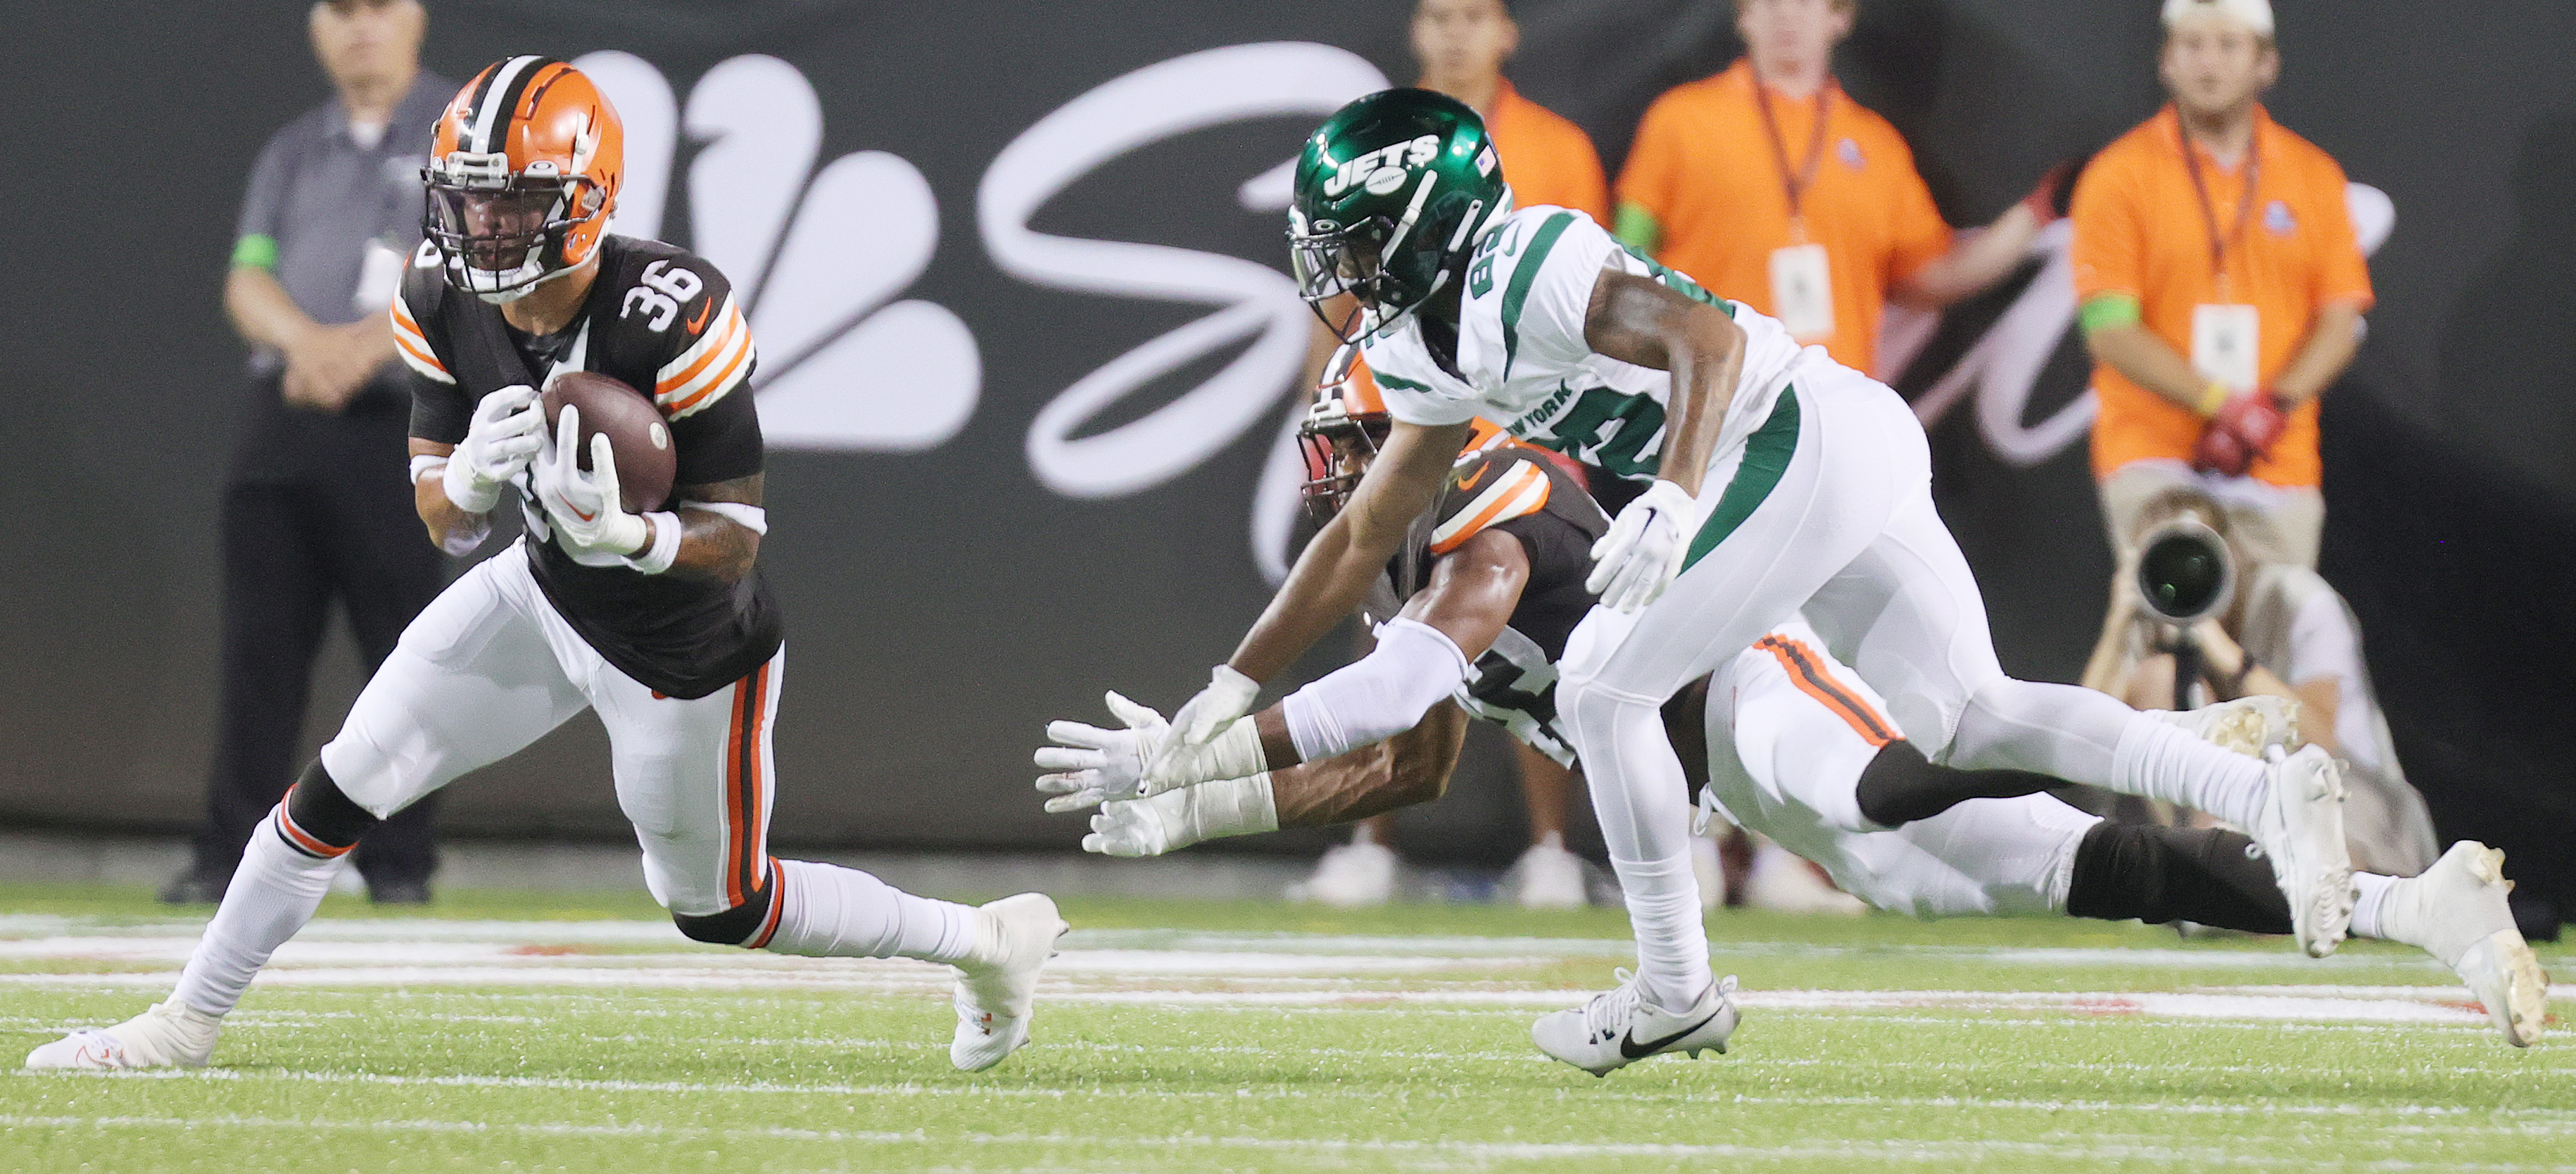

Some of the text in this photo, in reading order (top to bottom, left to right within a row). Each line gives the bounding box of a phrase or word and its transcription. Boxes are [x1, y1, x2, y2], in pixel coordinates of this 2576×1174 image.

[1324, 134, 1440, 196] JETS
[619, 259, 703, 332] 36
[1524, 378, 1572, 427] YORK
